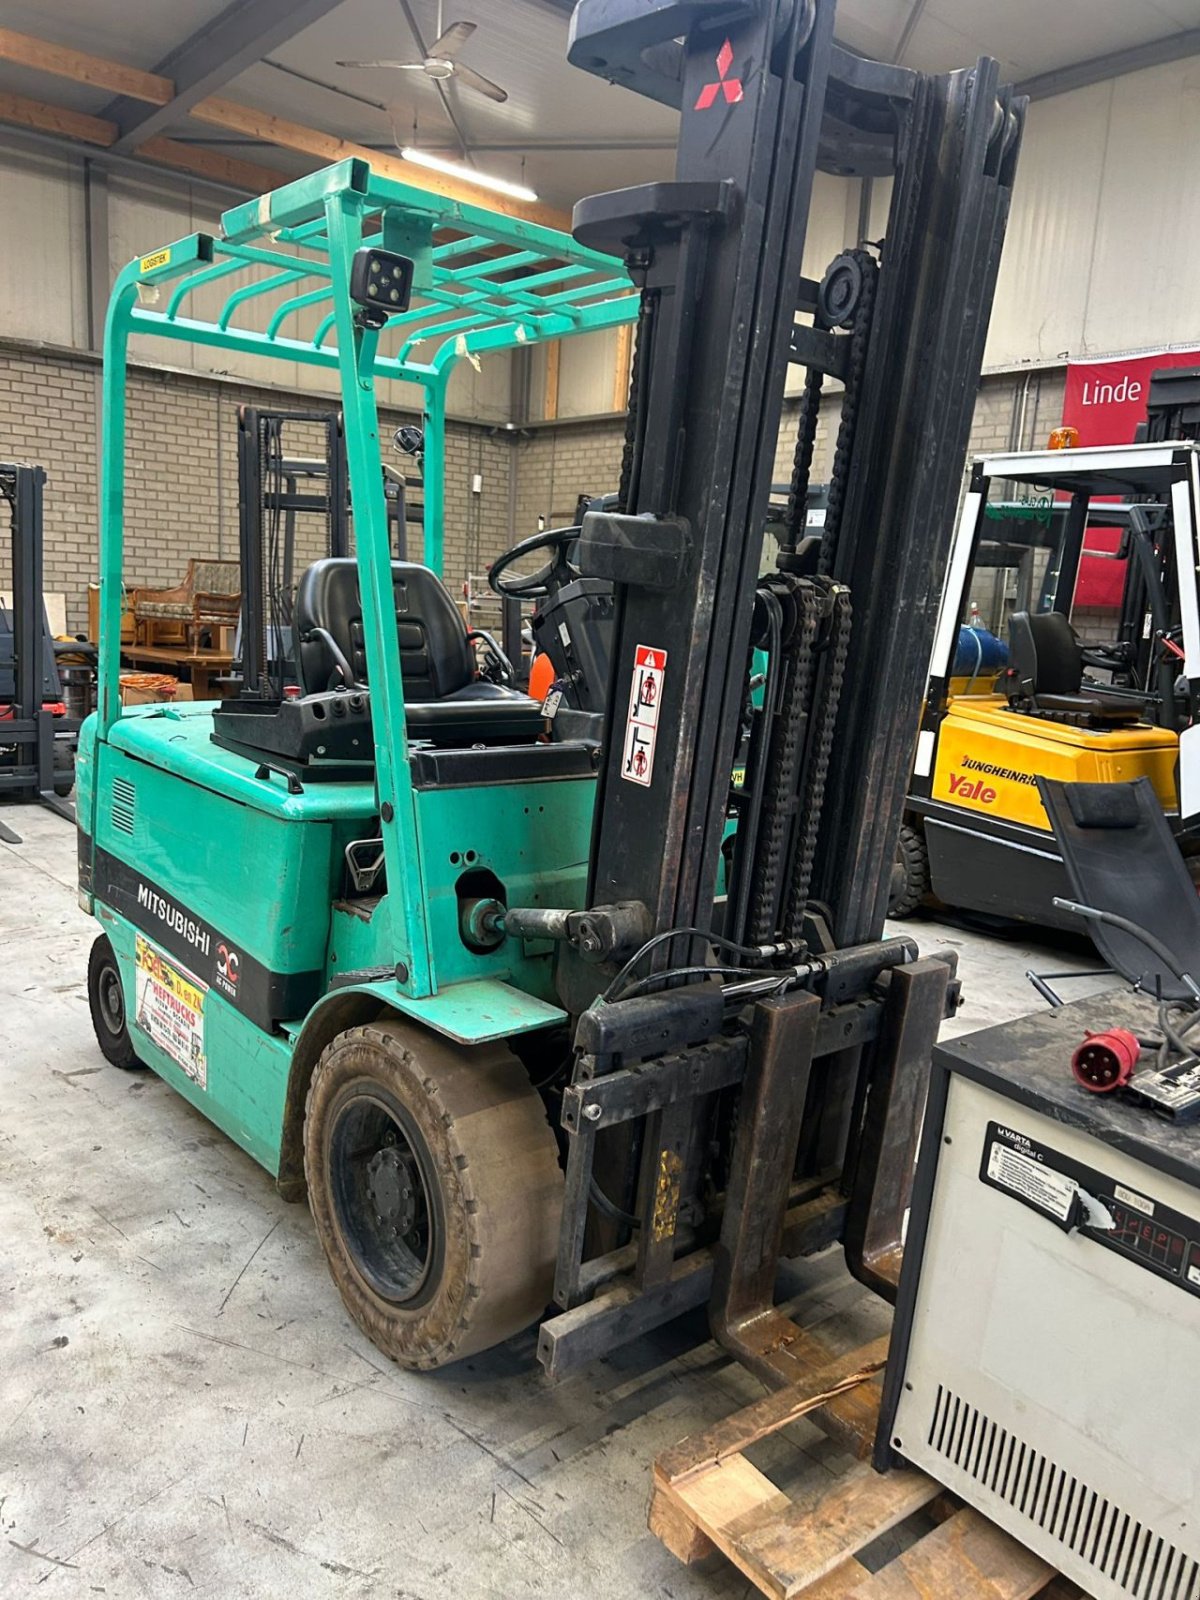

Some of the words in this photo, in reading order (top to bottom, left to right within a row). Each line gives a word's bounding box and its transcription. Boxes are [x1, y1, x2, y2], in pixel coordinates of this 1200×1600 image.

[1082, 376, 1141, 405] Linde
[961, 755, 1038, 787] JUNGHEINRIC
[948, 773, 996, 803] Yale
[138, 883, 210, 956] MITSUBISHI
[152, 983, 196, 1027] HEFTRUCKS
[1004, 1129, 1031, 1148] VARTA
[1014, 1142, 1037, 1158] digital
[1037, 1153, 1044, 1161] C
